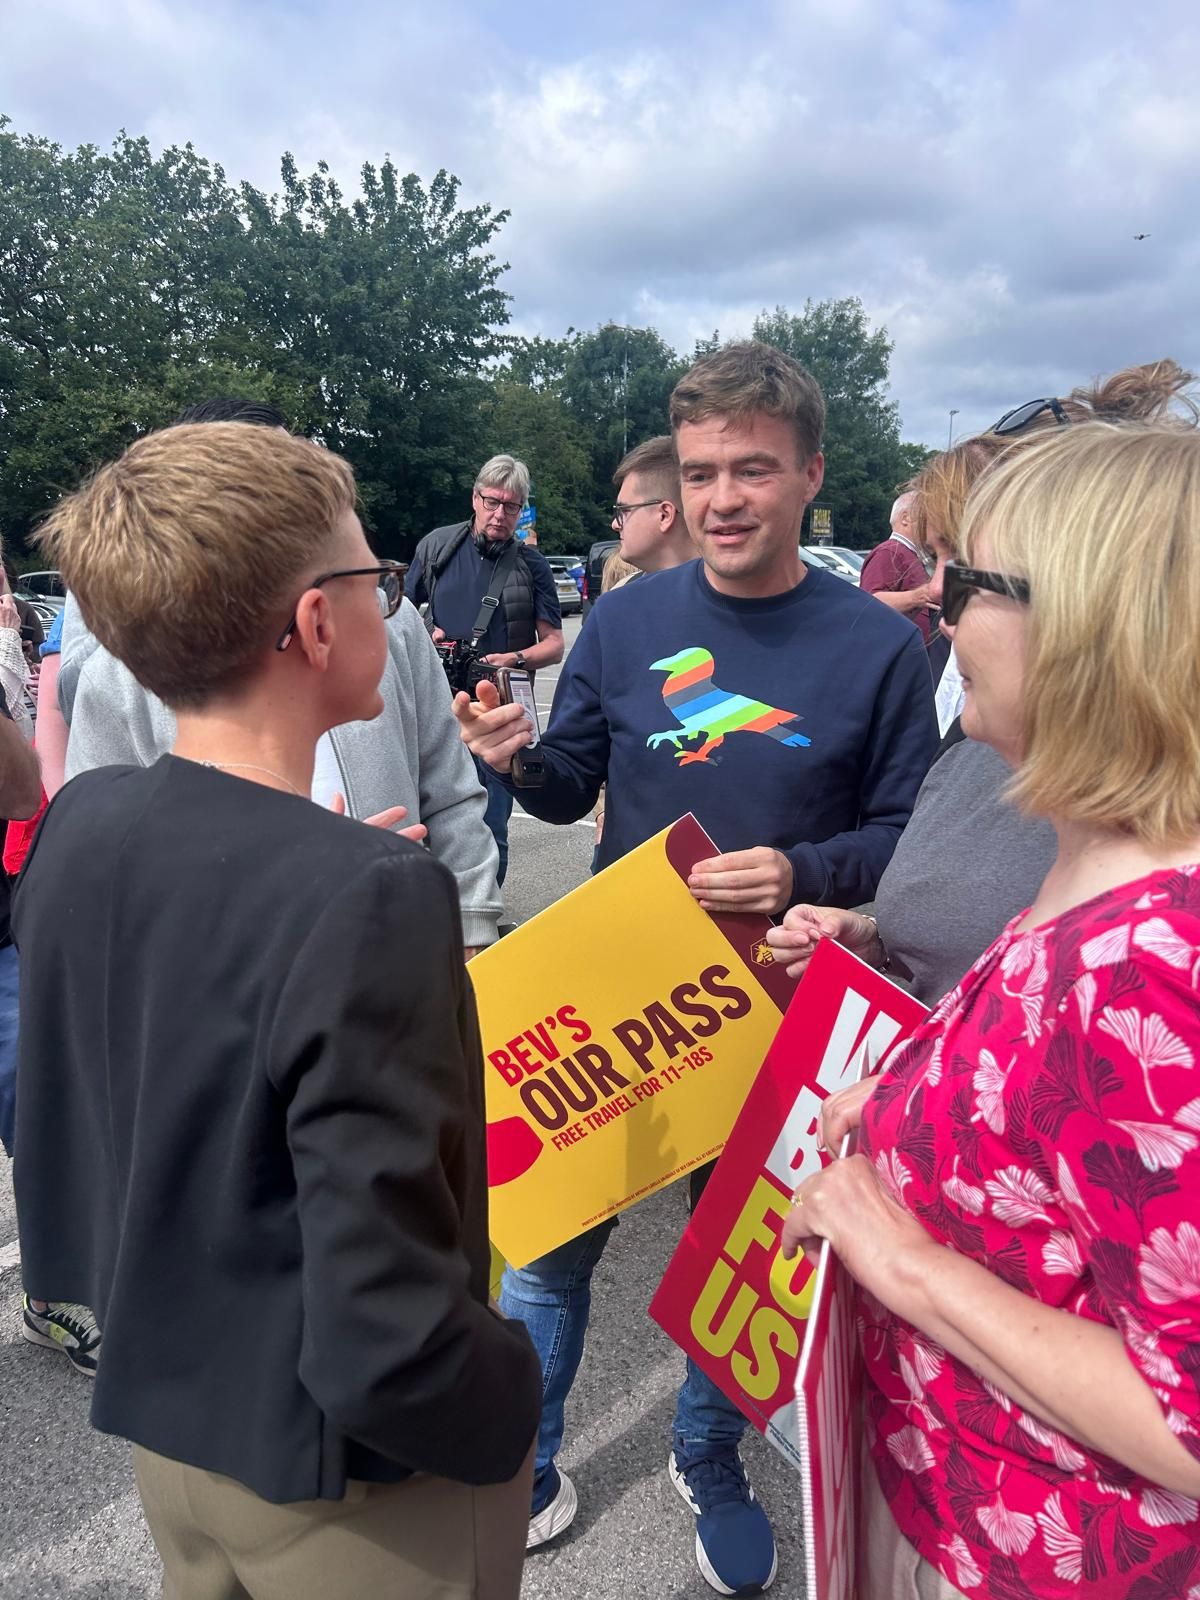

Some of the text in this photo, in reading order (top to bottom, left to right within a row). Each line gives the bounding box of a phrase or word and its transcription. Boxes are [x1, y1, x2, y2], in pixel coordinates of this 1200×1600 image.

[487, 1004, 592, 1088] BEV'S
[519, 1043, 632, 1131] OUR
[611, 964, 752, 1074] PASS
[550, 1045, 715, 1153] FREE TRAVEL FOR 11-18S
[690, 1257, 800, 1401] US
